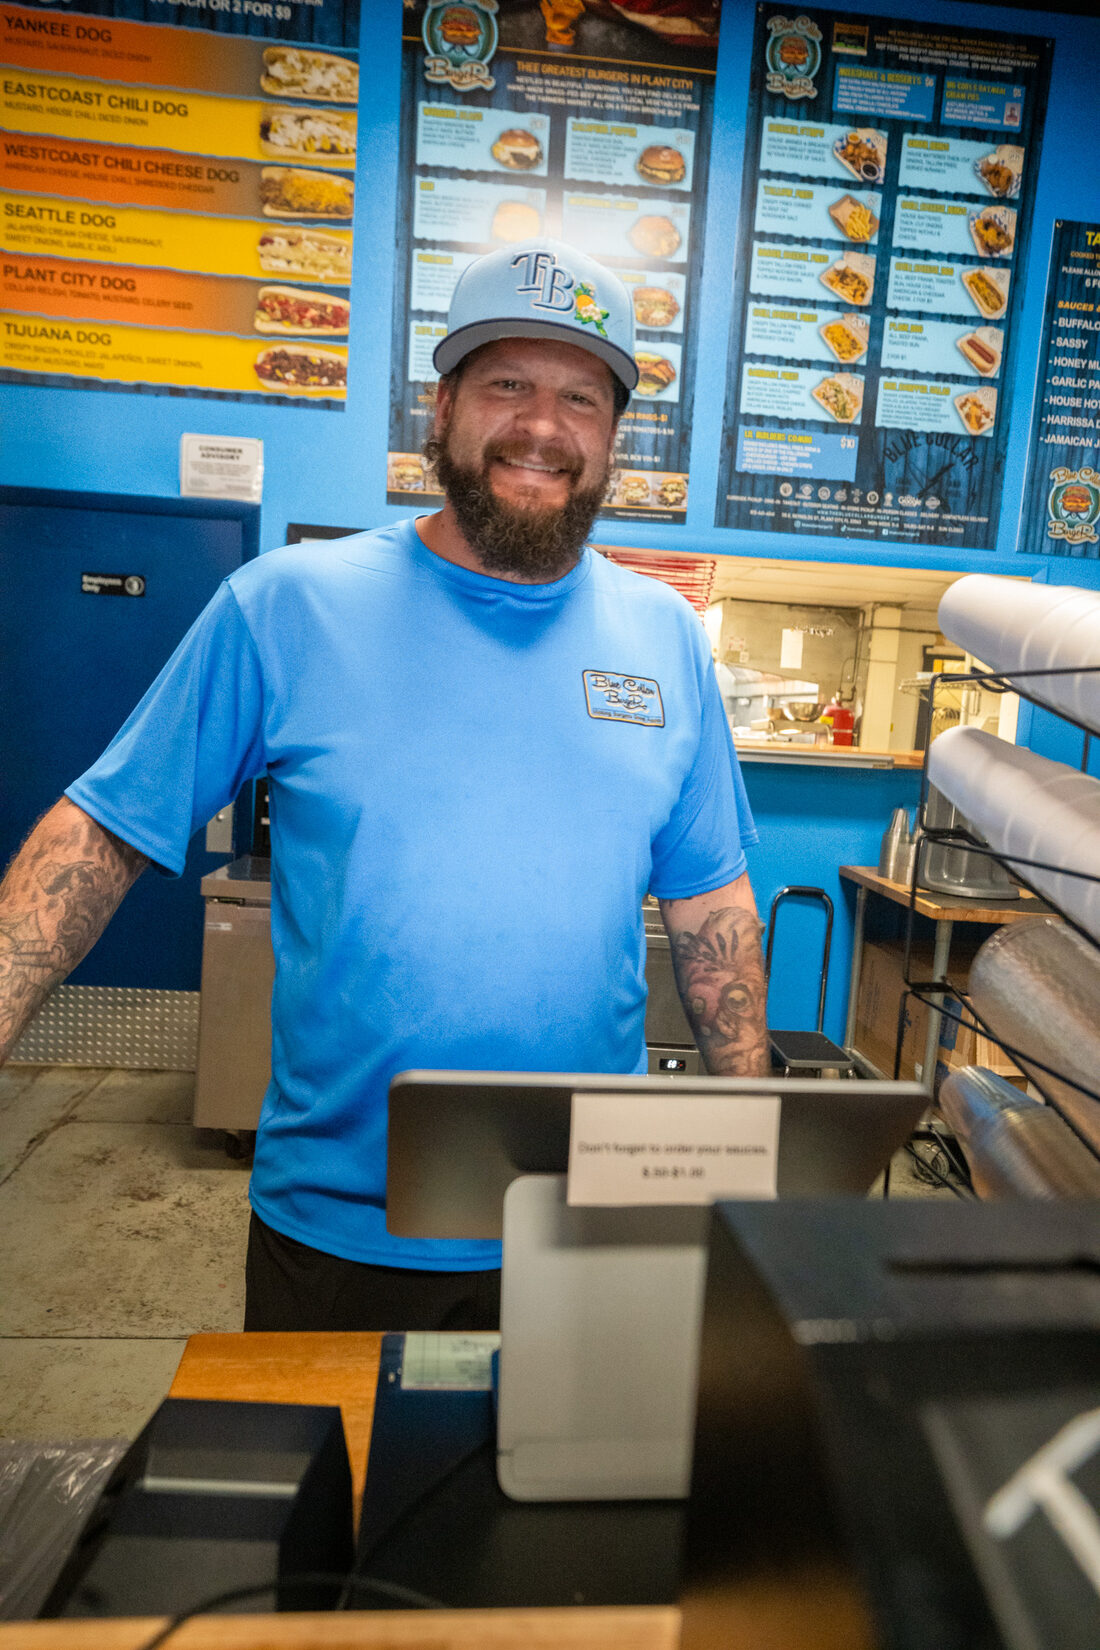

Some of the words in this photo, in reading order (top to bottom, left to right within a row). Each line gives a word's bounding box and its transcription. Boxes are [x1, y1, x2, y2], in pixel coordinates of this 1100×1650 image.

[209, 0, 231, 12] OR
[232, 3, 242, 14] 2
[243, 4, 273, 18] FOR
[275, 5, 292, 21] $9
[4, 15, 70, 37] YANKEE
[75, 27, 113, 43] DOG
[541, 64, 586, 79] GREATEST
[587, 68, 630, 84] BURGERS
[631, 73, 641, 84] IN
[641, 74, 671, 89] PLANT
[3, 80, 102, 106] EASTCOAST
[107, 94, 149, 113] CHILI
[152, 101, 189, 117] DOG
[4, 143, 101, 166] WESTCOAST
[103, 156, 142, 173] CHILI
[143, 160, 203, 179] CHEESE
[206, 167, 240, 183] DOG
[3, 202, 76, 225] SEATTLE
[80, 212, 117, 228] DOG
[3, 264, 59, 282] PLANT
[60, 270, 97, 287] CITY
[100, 275, 137, 292] DOG
[1062, 266, 1084, 275] PLEASE
[1057, 300, 1094, 312] SAUCES
[4, 322, 73, 342] TIJUANA
[76, 330, 112, 346] DOG
[1055, 337, 1089, 350] SASSY
[1053, 356, 1088, 370] HONEY
[1051, 376, 1087, 390] GARLIC
[1049, 395, 1083, 409] HOUSE
[1046, 414, 1095, 429] HARRISSA
[1044, 434, 1093, 449] JAMAICAN
[589, 674, 621, 690] Blue
